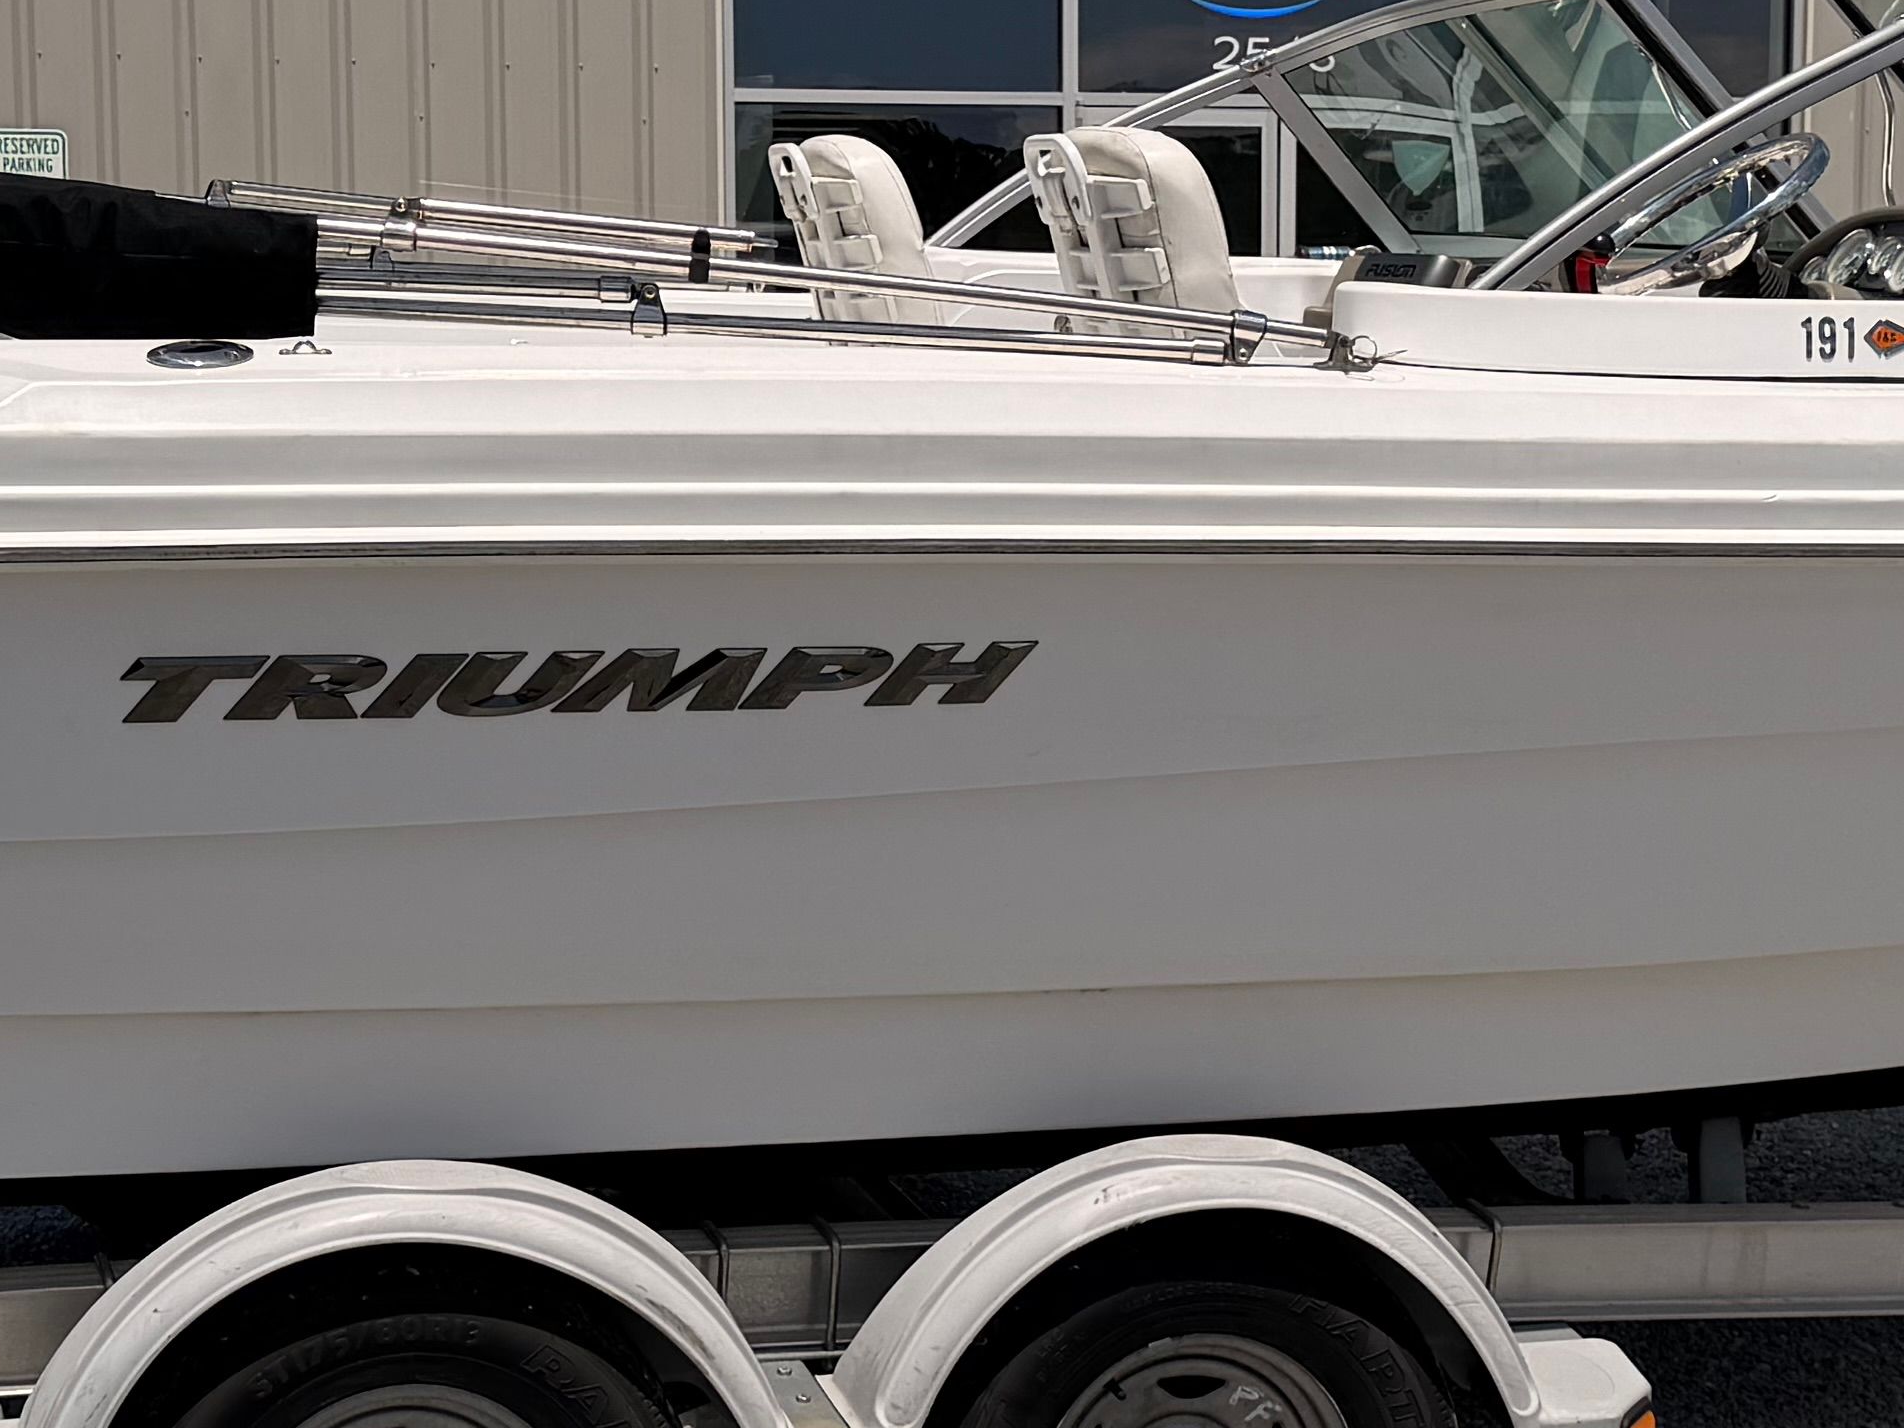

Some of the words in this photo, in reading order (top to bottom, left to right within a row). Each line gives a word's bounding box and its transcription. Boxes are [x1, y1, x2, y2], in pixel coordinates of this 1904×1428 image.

[2, 157, 53, 173] PARKING
[1800, 316, 1856, 363] 191
[119, 640, 1039, 723] TRIUMPH
